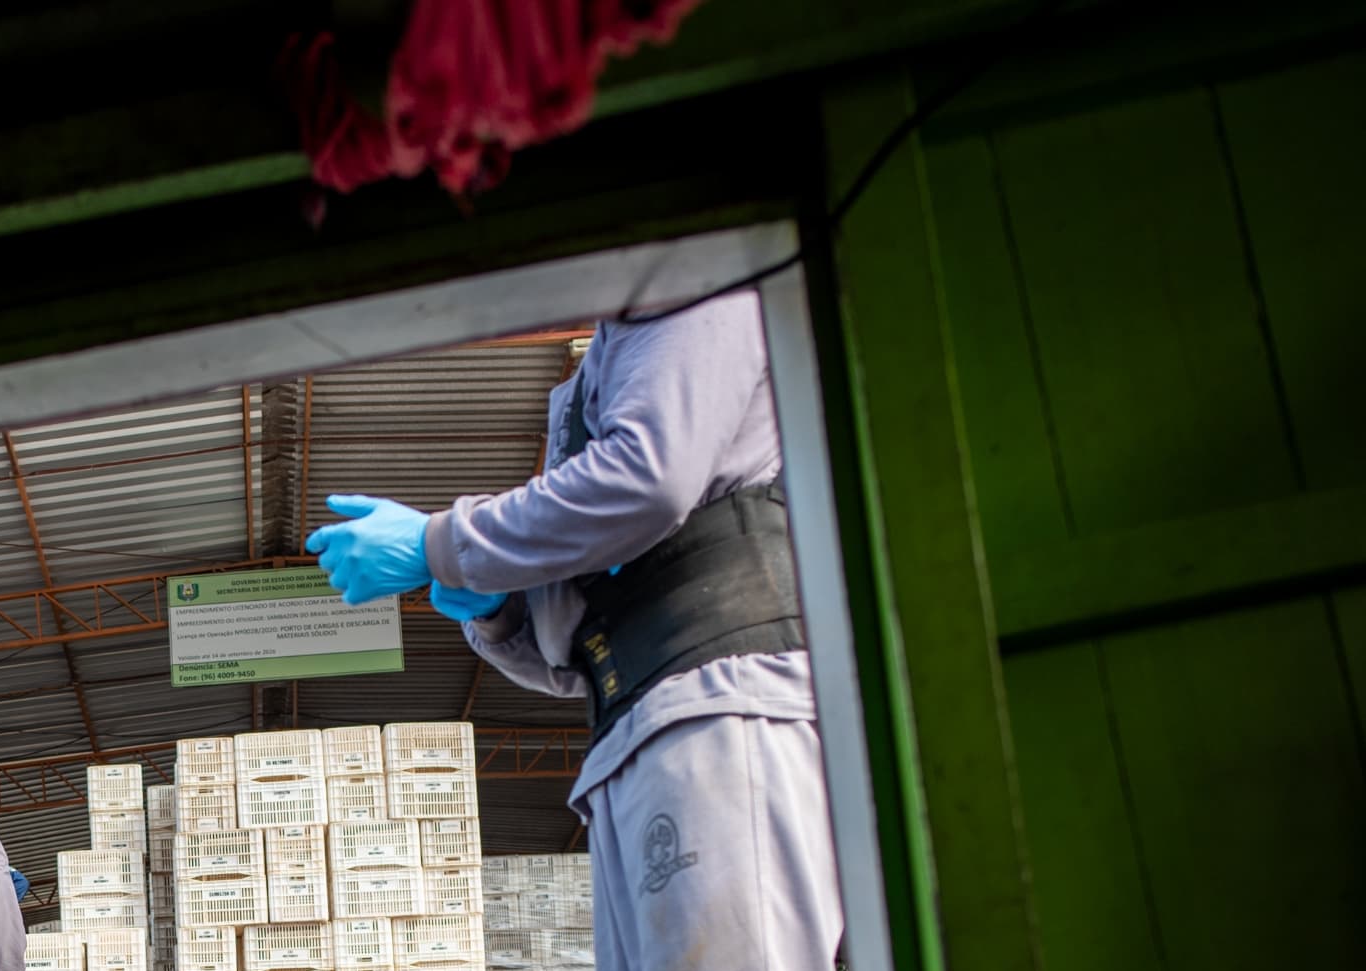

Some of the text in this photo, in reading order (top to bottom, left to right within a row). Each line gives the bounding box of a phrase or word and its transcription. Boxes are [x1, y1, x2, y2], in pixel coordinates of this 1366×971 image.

[231, 578, 261, 586] GOVERNO
[216, 586, 251, 595] SECRETARIA
[233, 602, 268, 611] LICENCIADO
[346, 619, 380, 628] DESCARGA
[276, 632, 309, 640] MATERIAIS
[178, 661, 240, 672] Denúncia: SEMA
[179, 670, 256, 682] Fone: (96) 4009-9450
